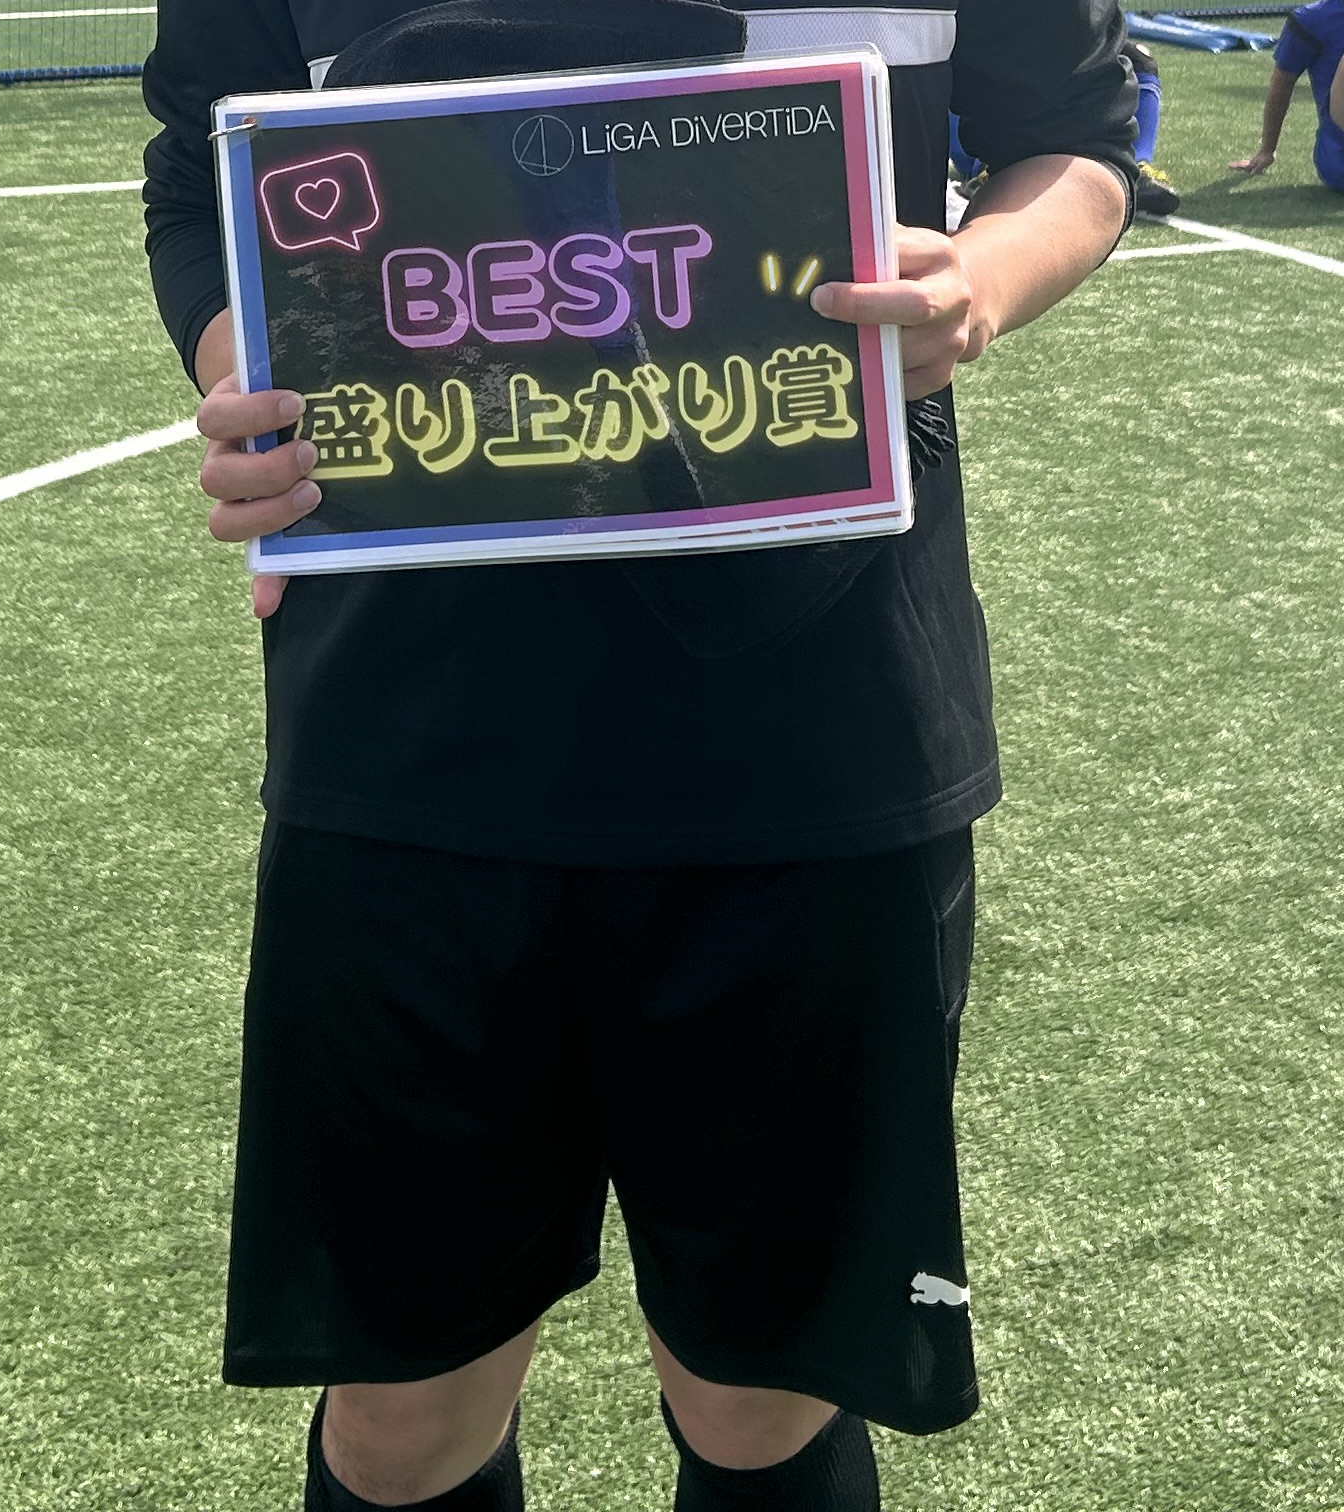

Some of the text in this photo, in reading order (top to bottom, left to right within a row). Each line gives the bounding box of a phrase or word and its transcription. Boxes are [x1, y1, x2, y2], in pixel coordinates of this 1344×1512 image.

[381, 223, 713, 349] BEST
[294, 343, 858, 480] 盛り上がり賞
